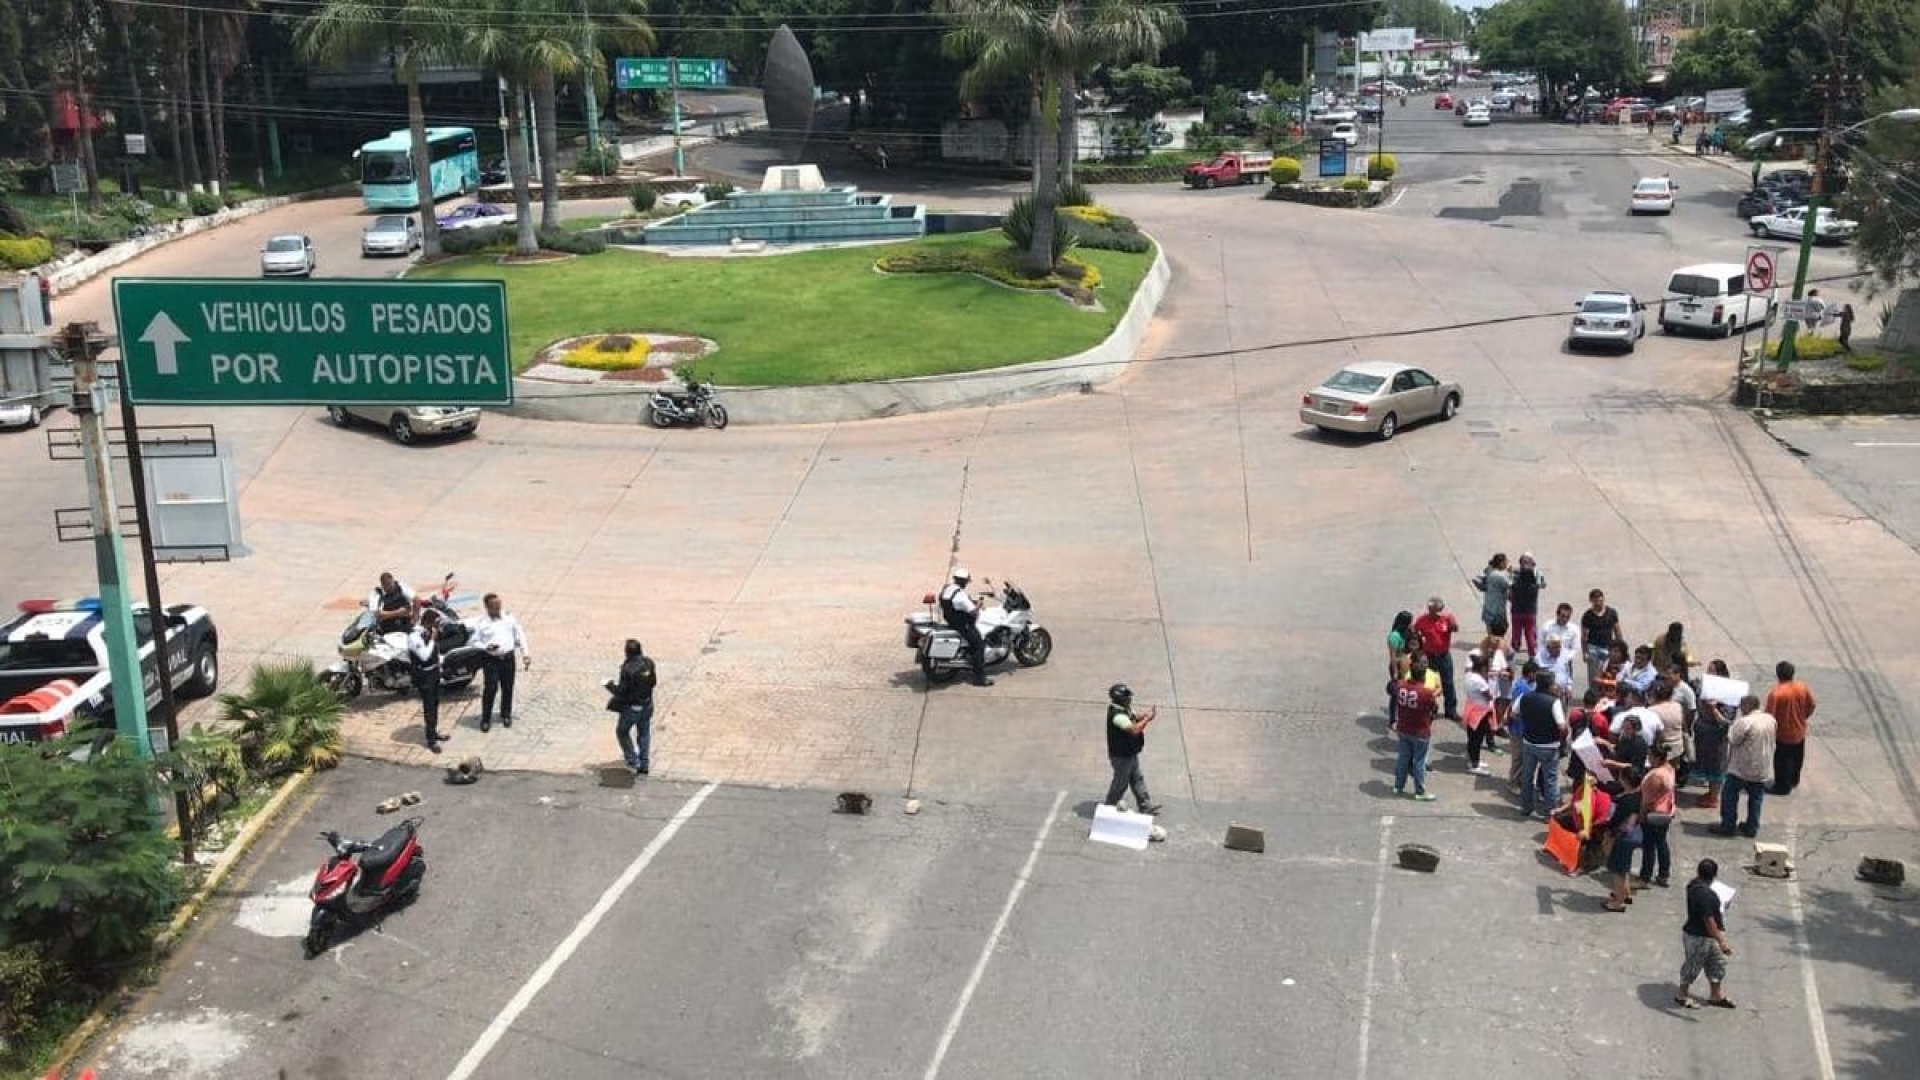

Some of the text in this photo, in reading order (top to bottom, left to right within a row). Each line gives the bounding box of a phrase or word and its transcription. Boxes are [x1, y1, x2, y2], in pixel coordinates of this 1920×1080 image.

[201, 302, 492, 334] VEHICULOS PESADOS
[210, 353, 497, 385] POR AUTOPISTA
[1398, 688, 1418, 708] 92
